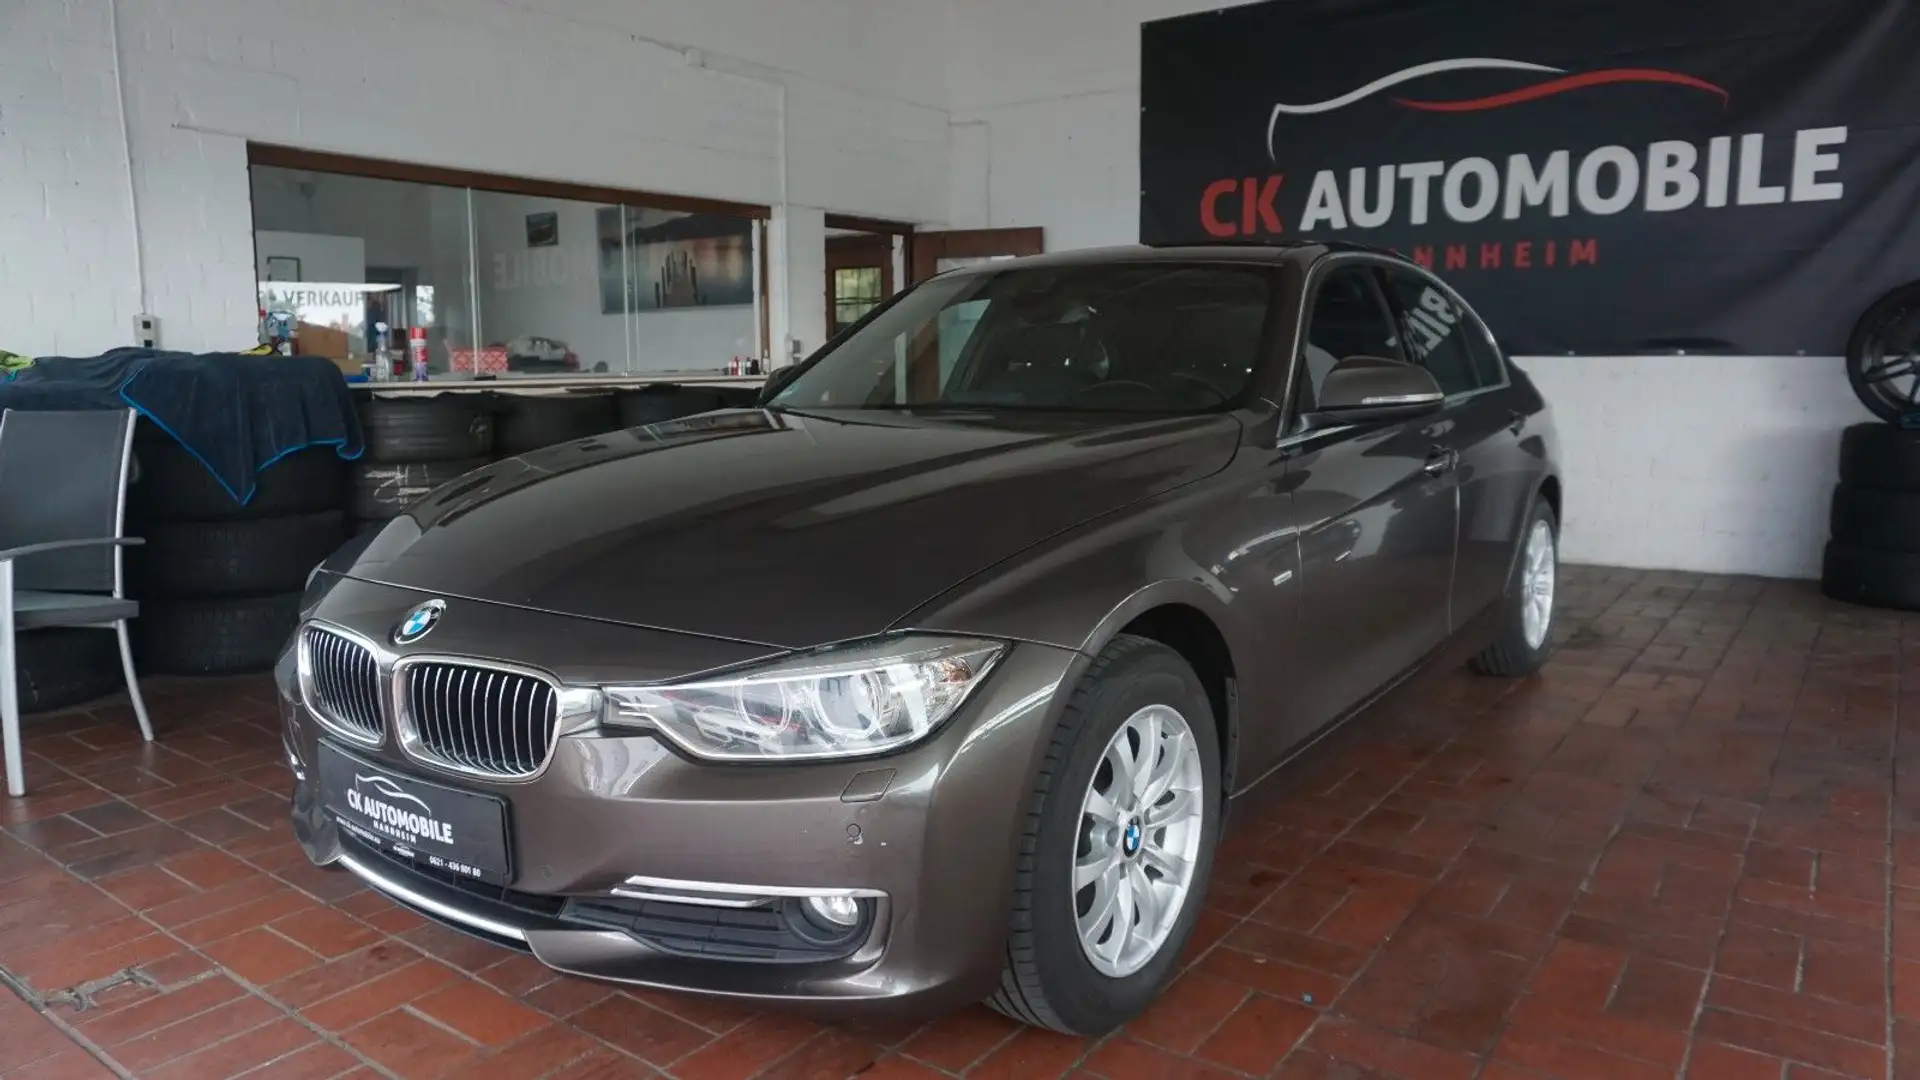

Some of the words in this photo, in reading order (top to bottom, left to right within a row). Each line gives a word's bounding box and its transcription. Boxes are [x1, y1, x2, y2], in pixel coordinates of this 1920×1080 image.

[1200, 174, 1284, 237] CK
[1298, 126, 1848, 232] AUTOMOBILE
[1390, 239, 1598, 271] NNHEIM
[283, 289, 366, 307] VERKAUF
[347, 788, 363, 812] CK
[364, 796, 454, 844] AUTOMOBILE
